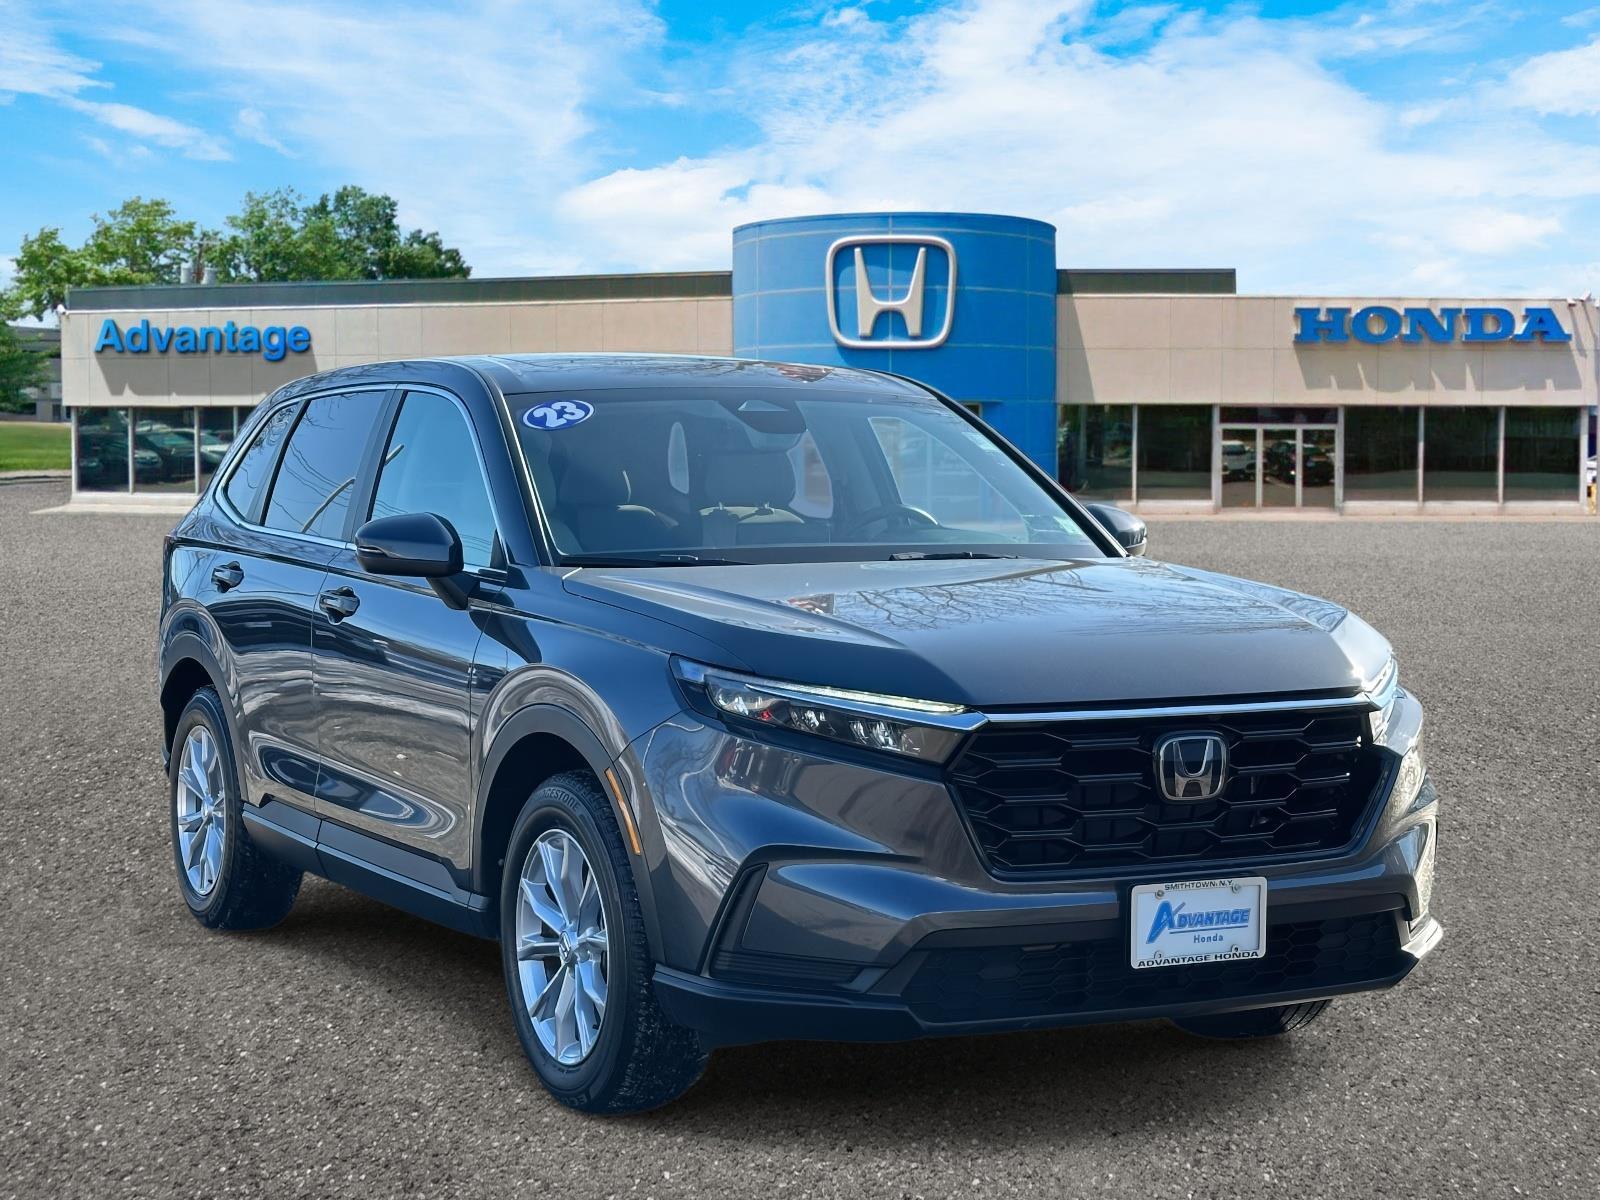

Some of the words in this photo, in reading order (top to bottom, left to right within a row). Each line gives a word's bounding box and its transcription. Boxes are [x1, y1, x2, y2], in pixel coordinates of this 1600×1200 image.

[95, 319, 311, 361] Advantage
[1294, 306, 1572, 343] HONDA
[532, 401, 586, 428] 23
[1146, 900, 1251, 944] ADVANTAGE
[1193, 933, 1224, 943] Honda
[1137, 953, 1212, 968] ADVANTAGE
[1214, 950, 1259, 960] HONDA
